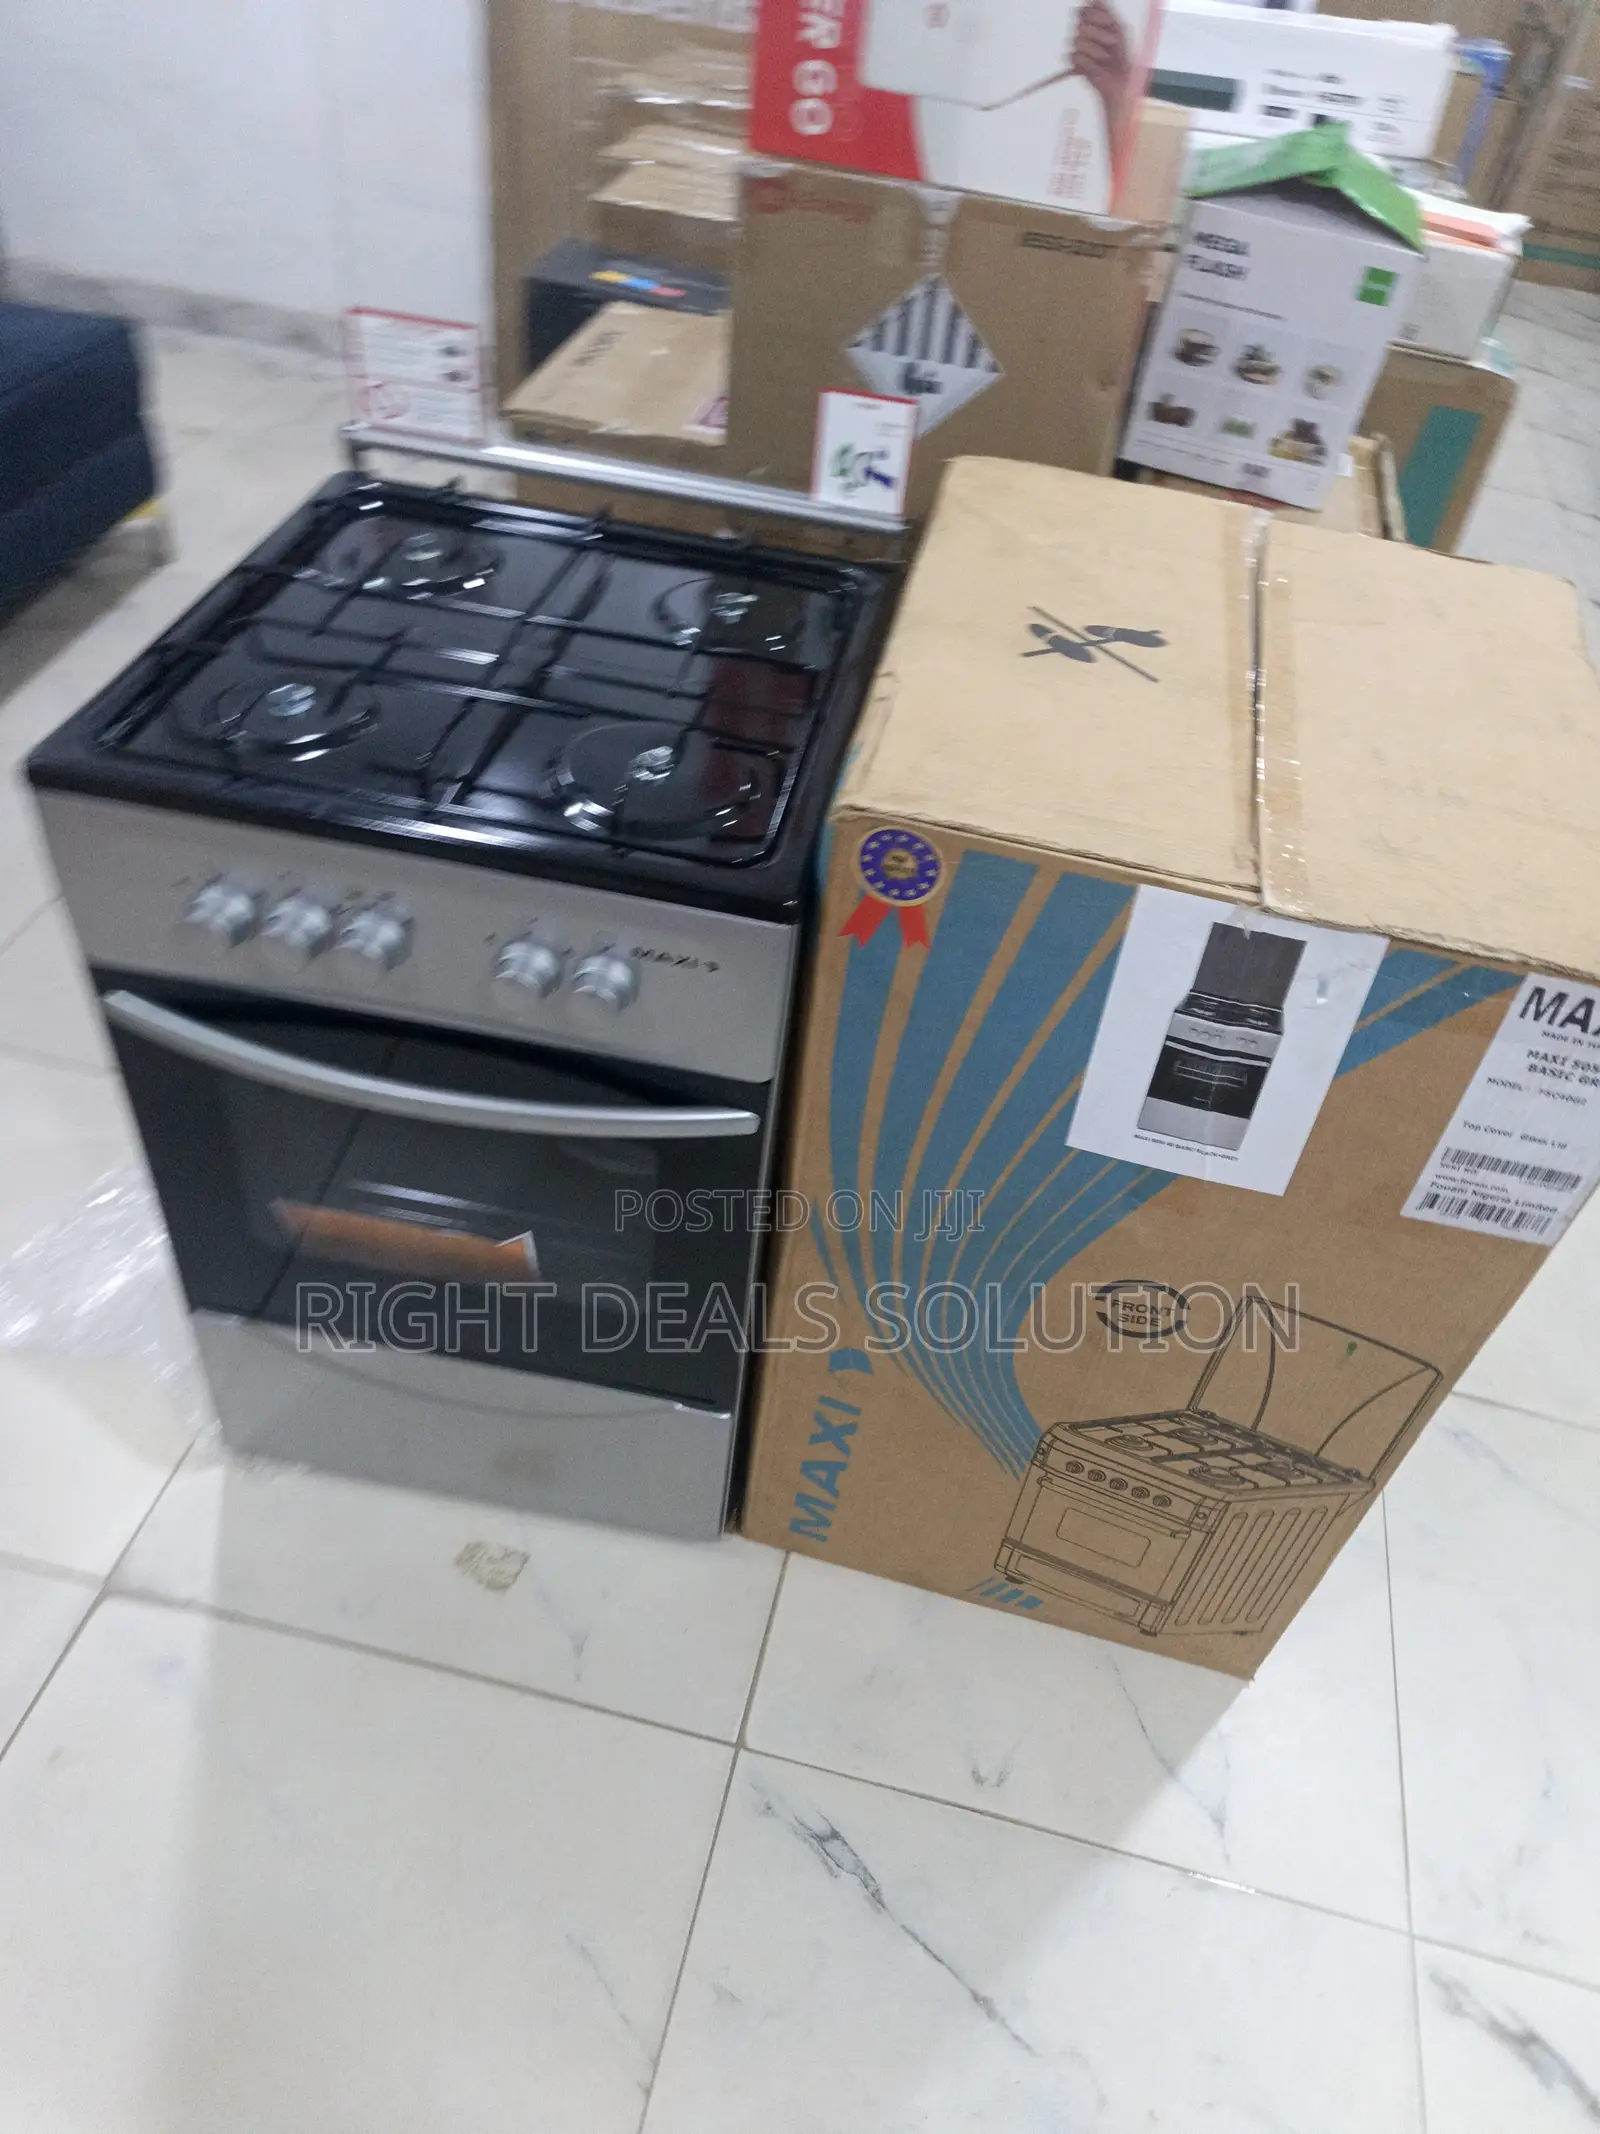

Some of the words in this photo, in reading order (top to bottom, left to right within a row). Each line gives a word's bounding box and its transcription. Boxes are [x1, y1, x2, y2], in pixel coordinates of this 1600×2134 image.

[788, 59, 838, 136] GO
[1518, 985, 1600, 1037] MA
[1111, 1300, 1172, 1318] FRONT
[1118, 1313, 1160, 1328] SIDE
[788, 1395, 862, 1543] MAXI
